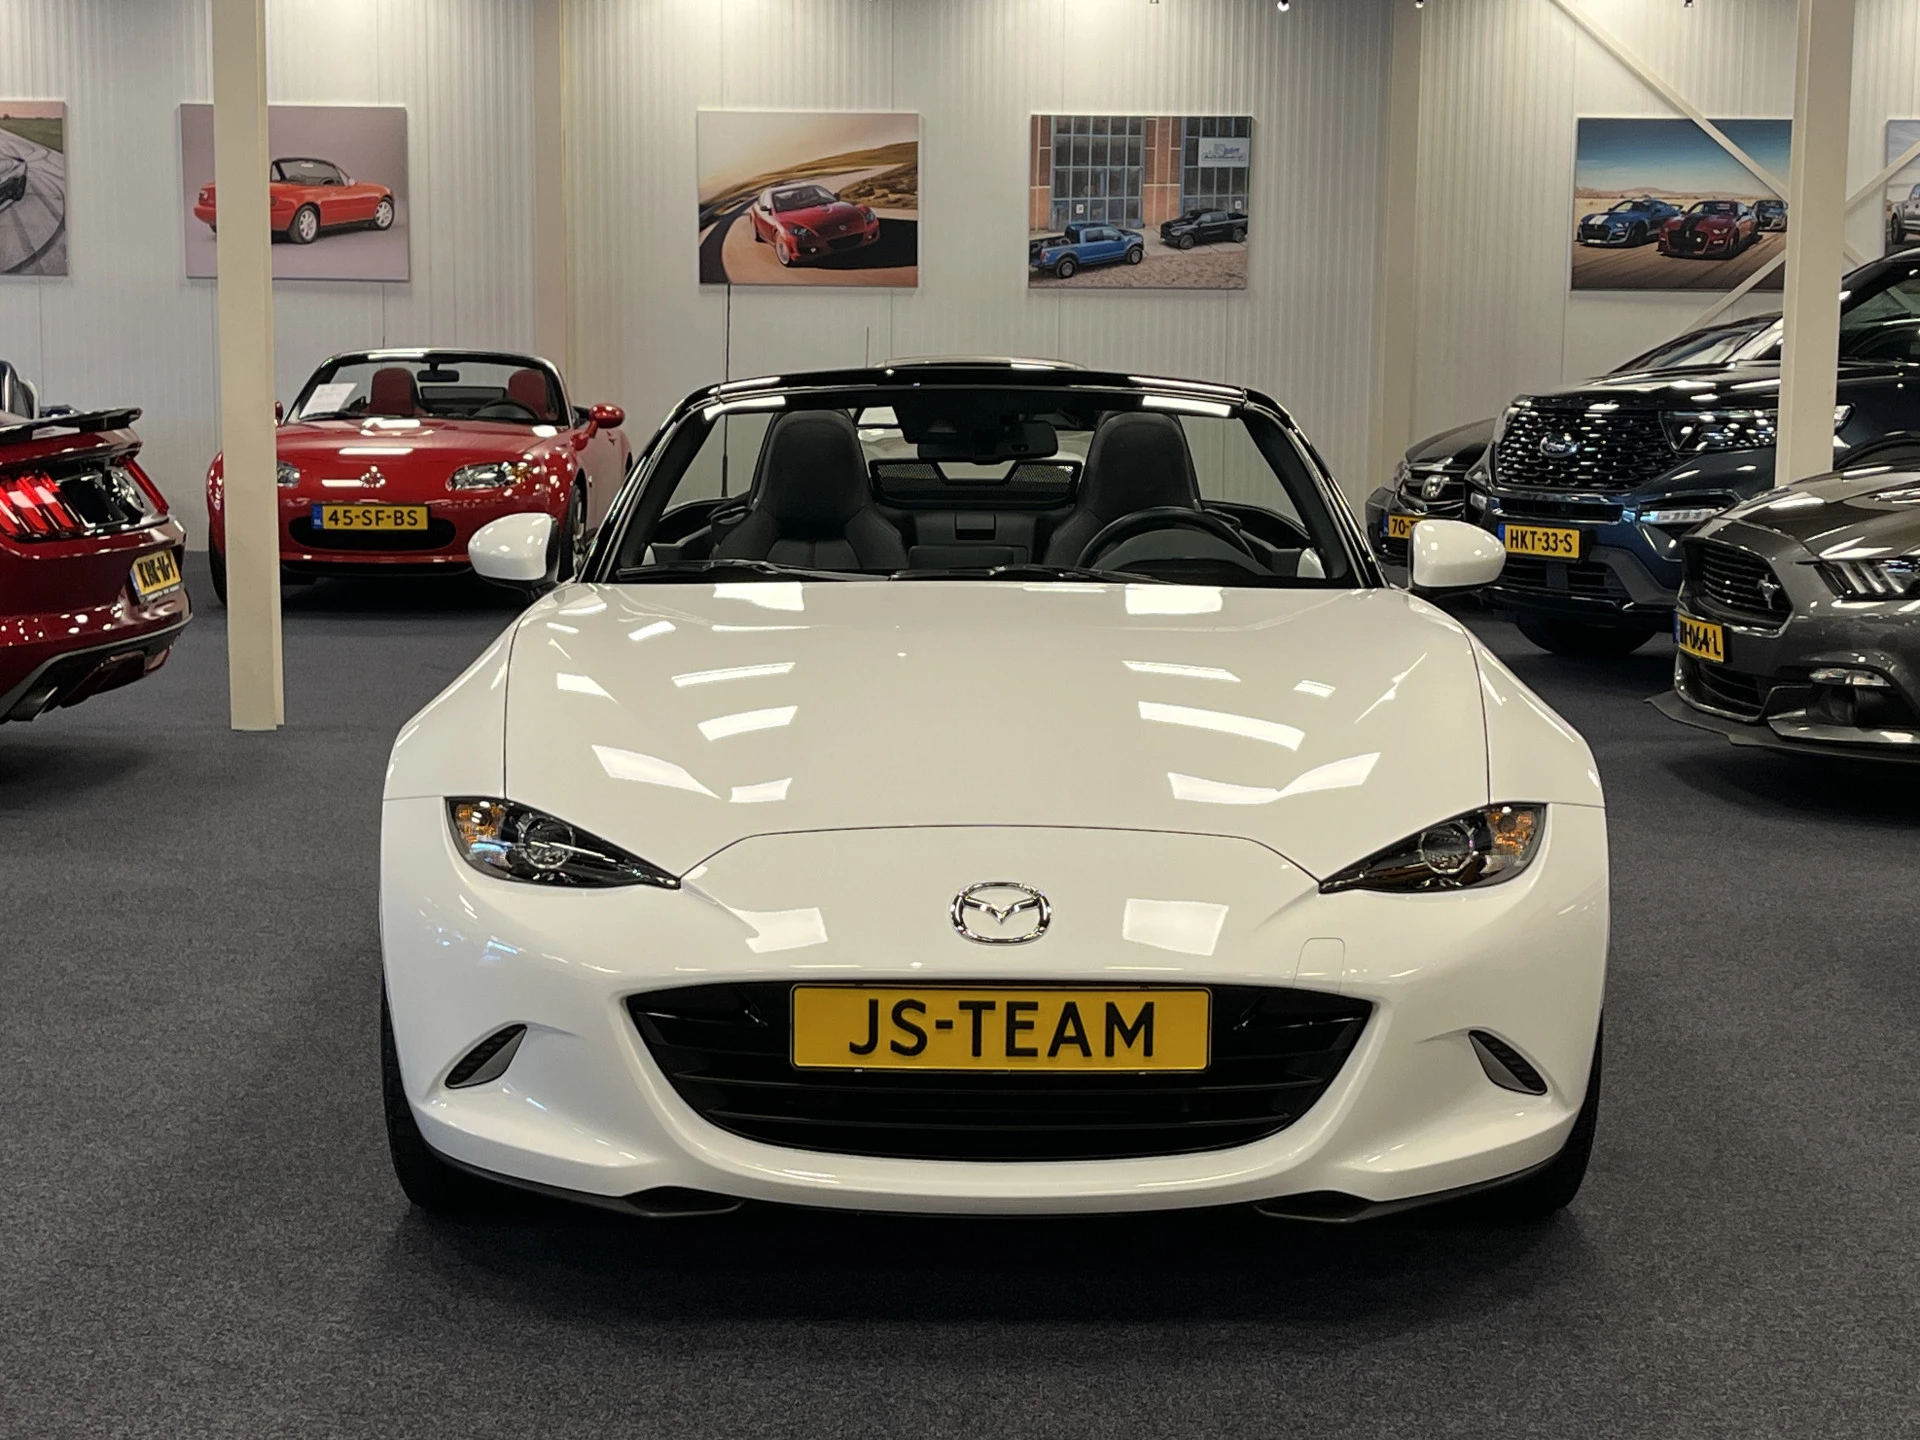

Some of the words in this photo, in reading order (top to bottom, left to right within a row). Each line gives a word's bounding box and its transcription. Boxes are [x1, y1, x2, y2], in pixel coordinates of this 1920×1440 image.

[328, 509, 418, 527] 45-SF-BS
[1392, 518, 1418, 535] 70-
[1510, 529, 1573, 553] HKT-33-S
[849, 999, 1155, 1058] JS-TEAM
